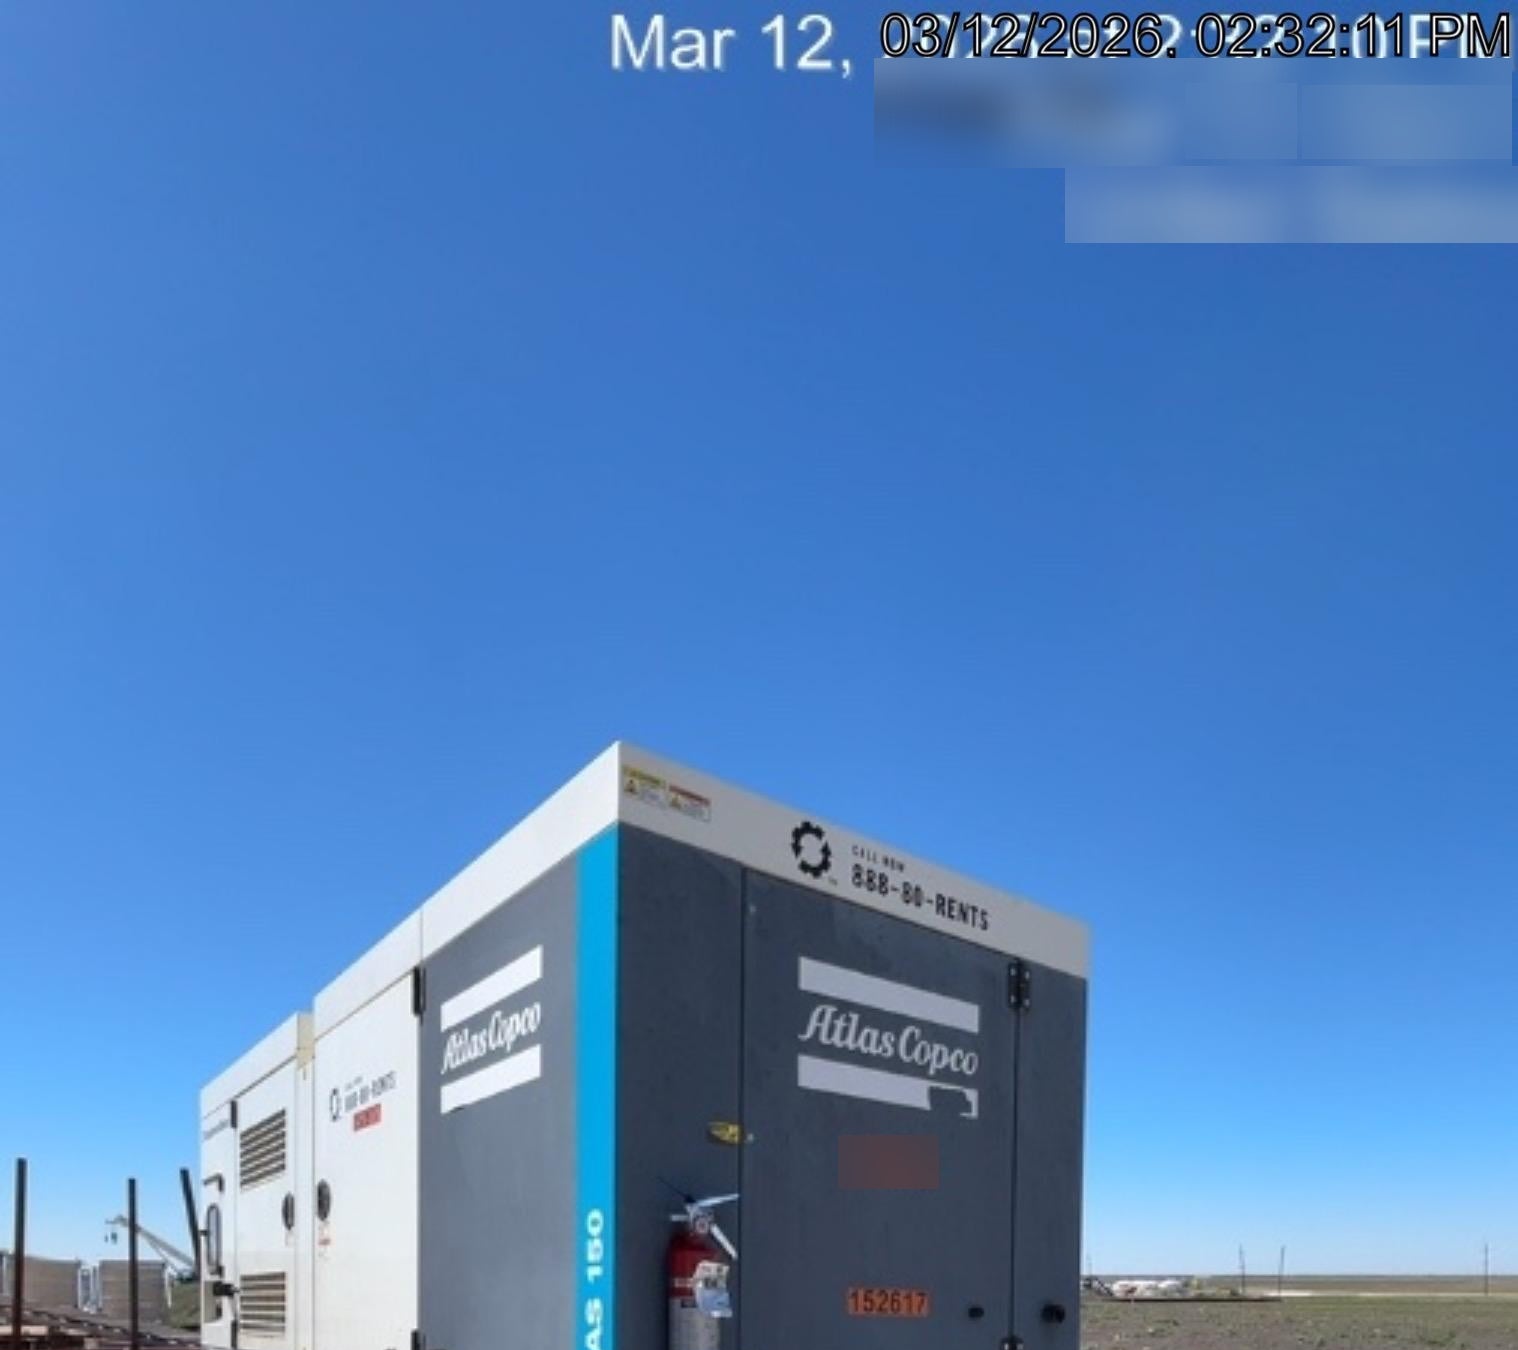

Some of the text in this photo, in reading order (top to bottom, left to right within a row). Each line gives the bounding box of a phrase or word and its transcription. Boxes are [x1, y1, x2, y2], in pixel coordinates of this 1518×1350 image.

[851, 862, 989, 931] 888-80-RENTS
[441, 1001, 541, 1075] Atlas Copco
[798, 1004, 979, 1076] Atlas Copco
[585, 1208, 605, 1285] 150
[851, 1288, 928, 1314] 152617
